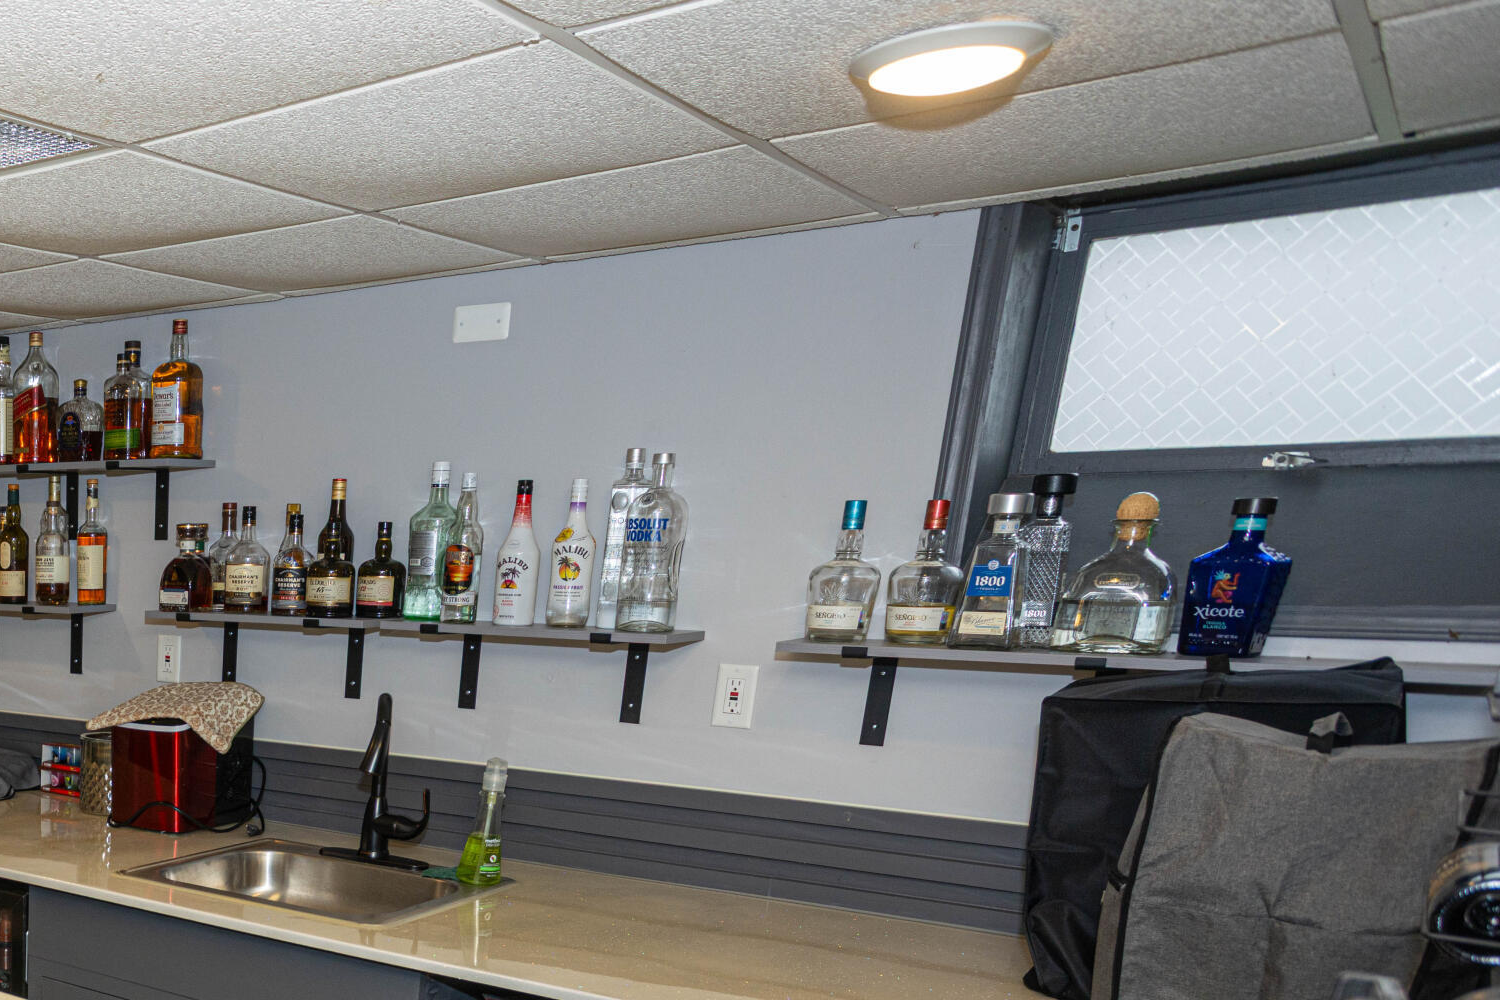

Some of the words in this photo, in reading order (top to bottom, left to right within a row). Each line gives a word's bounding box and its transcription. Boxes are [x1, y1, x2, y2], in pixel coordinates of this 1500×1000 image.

[625, 517, 669, 530] ABSOLUT
[626, 530, 662, 542] VODKA
[553, 544, 590, 560] MALIBU
[497, 556, 529, 570] MALIBU
[975, 575, 1006, 587] 1800
[1024, 609, 1047, 618] 1800
